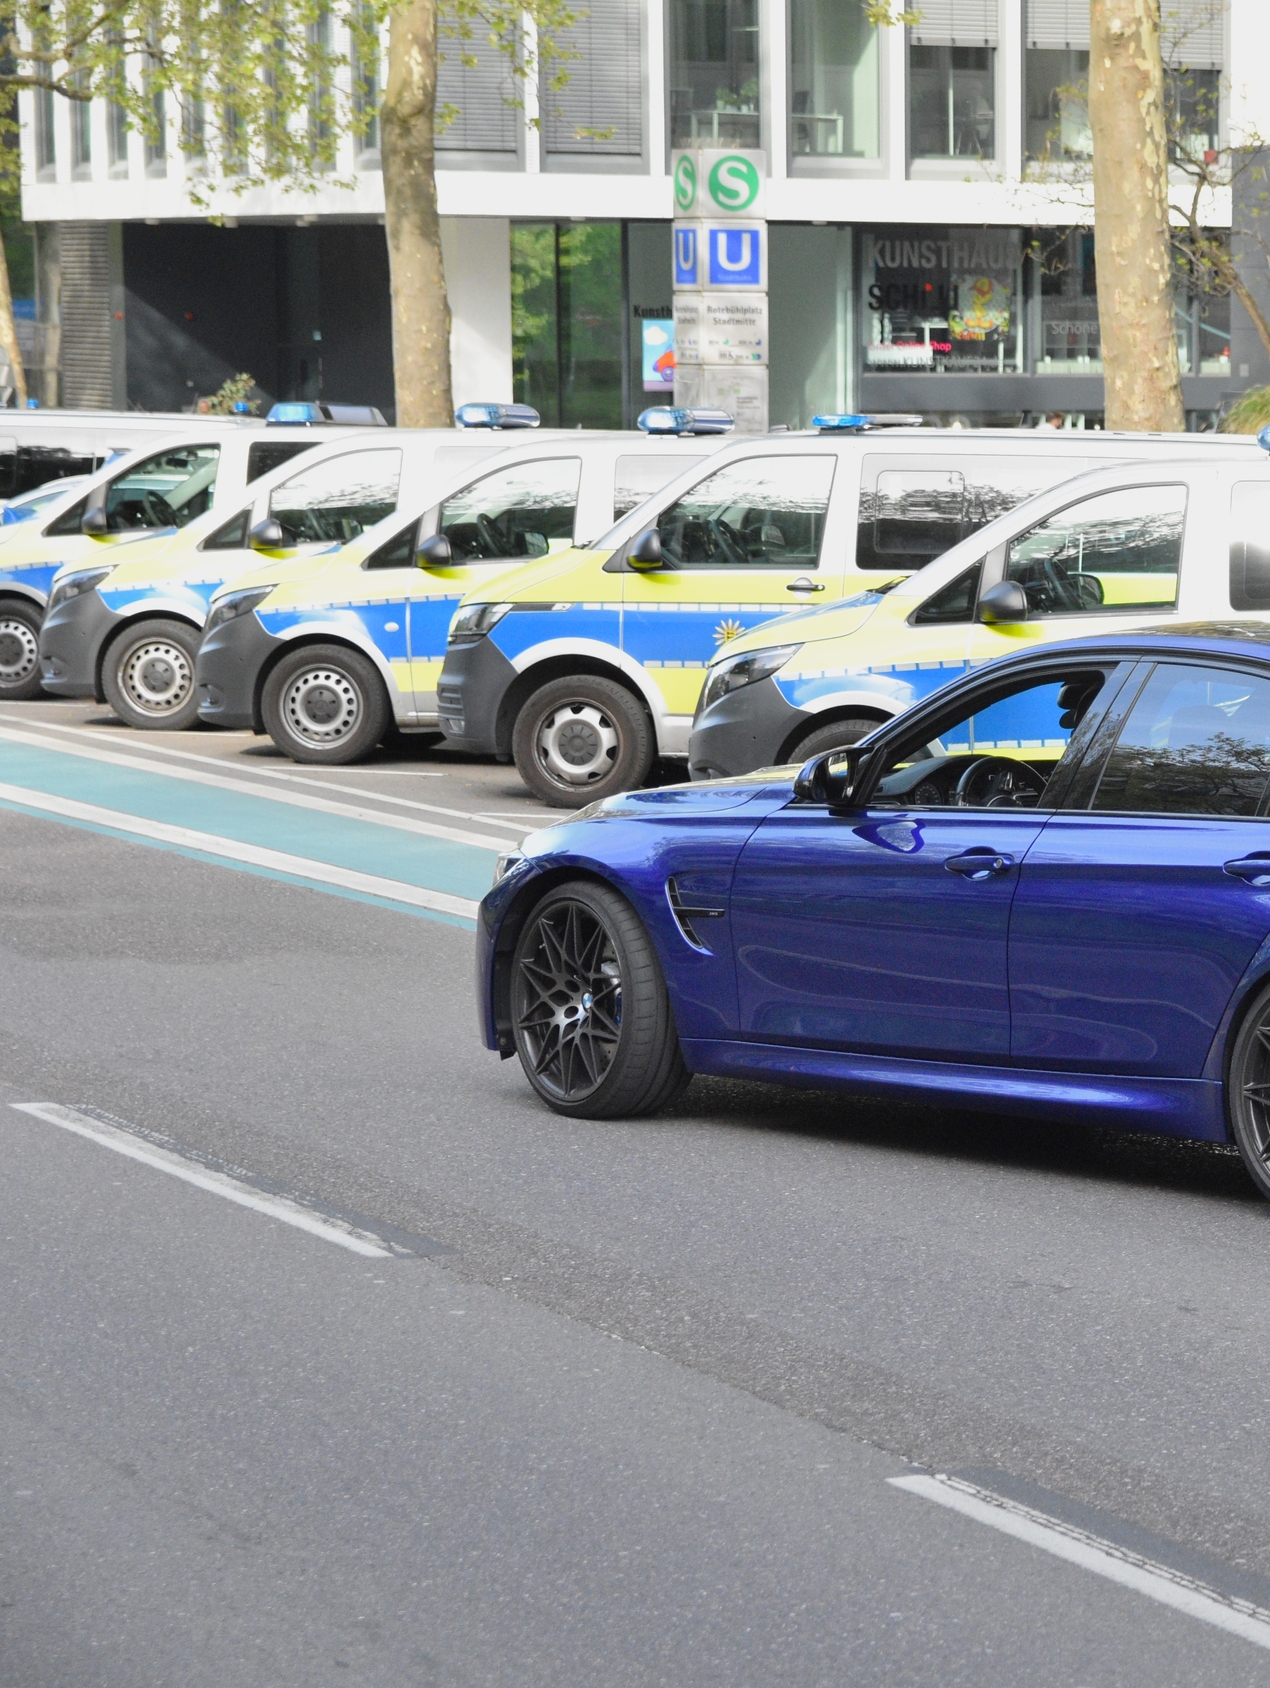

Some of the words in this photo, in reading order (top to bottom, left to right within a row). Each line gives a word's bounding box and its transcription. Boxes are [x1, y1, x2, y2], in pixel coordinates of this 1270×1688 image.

[717, 160, 750, 207] S
[678, 232, 694, 271] U
[717, 231, 752, 272] U
